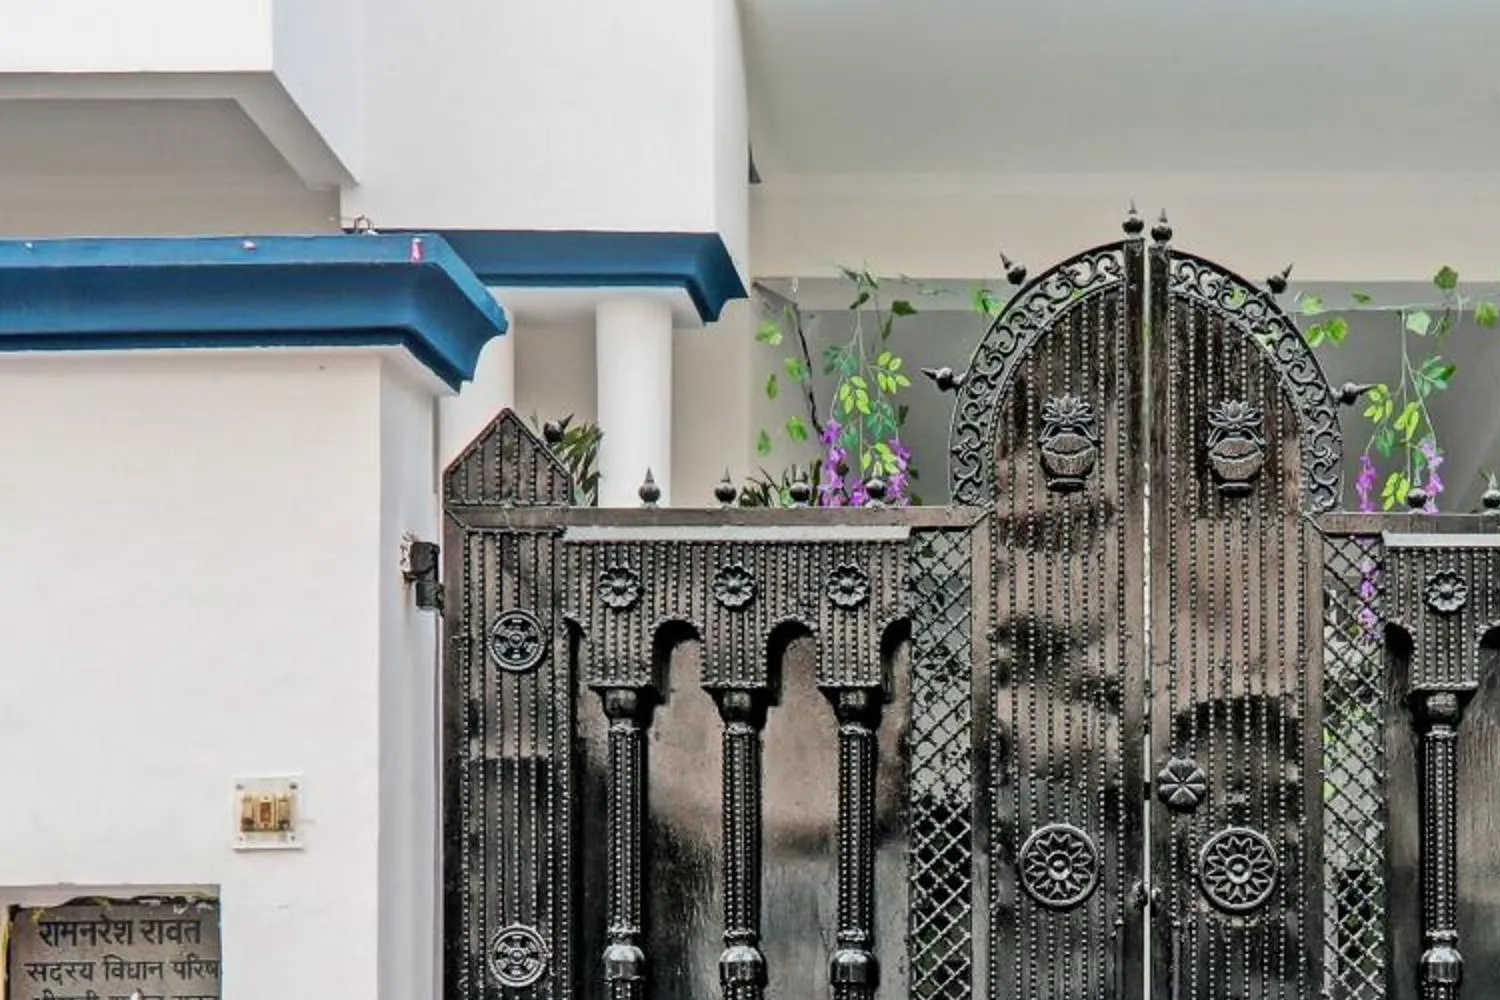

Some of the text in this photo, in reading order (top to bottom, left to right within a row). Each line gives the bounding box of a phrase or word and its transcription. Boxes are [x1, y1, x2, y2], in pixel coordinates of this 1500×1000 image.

[39, 914, 202, 946] रामनरेश रावत
[25, 954, 221, 985] सदस्य विधान परिष
